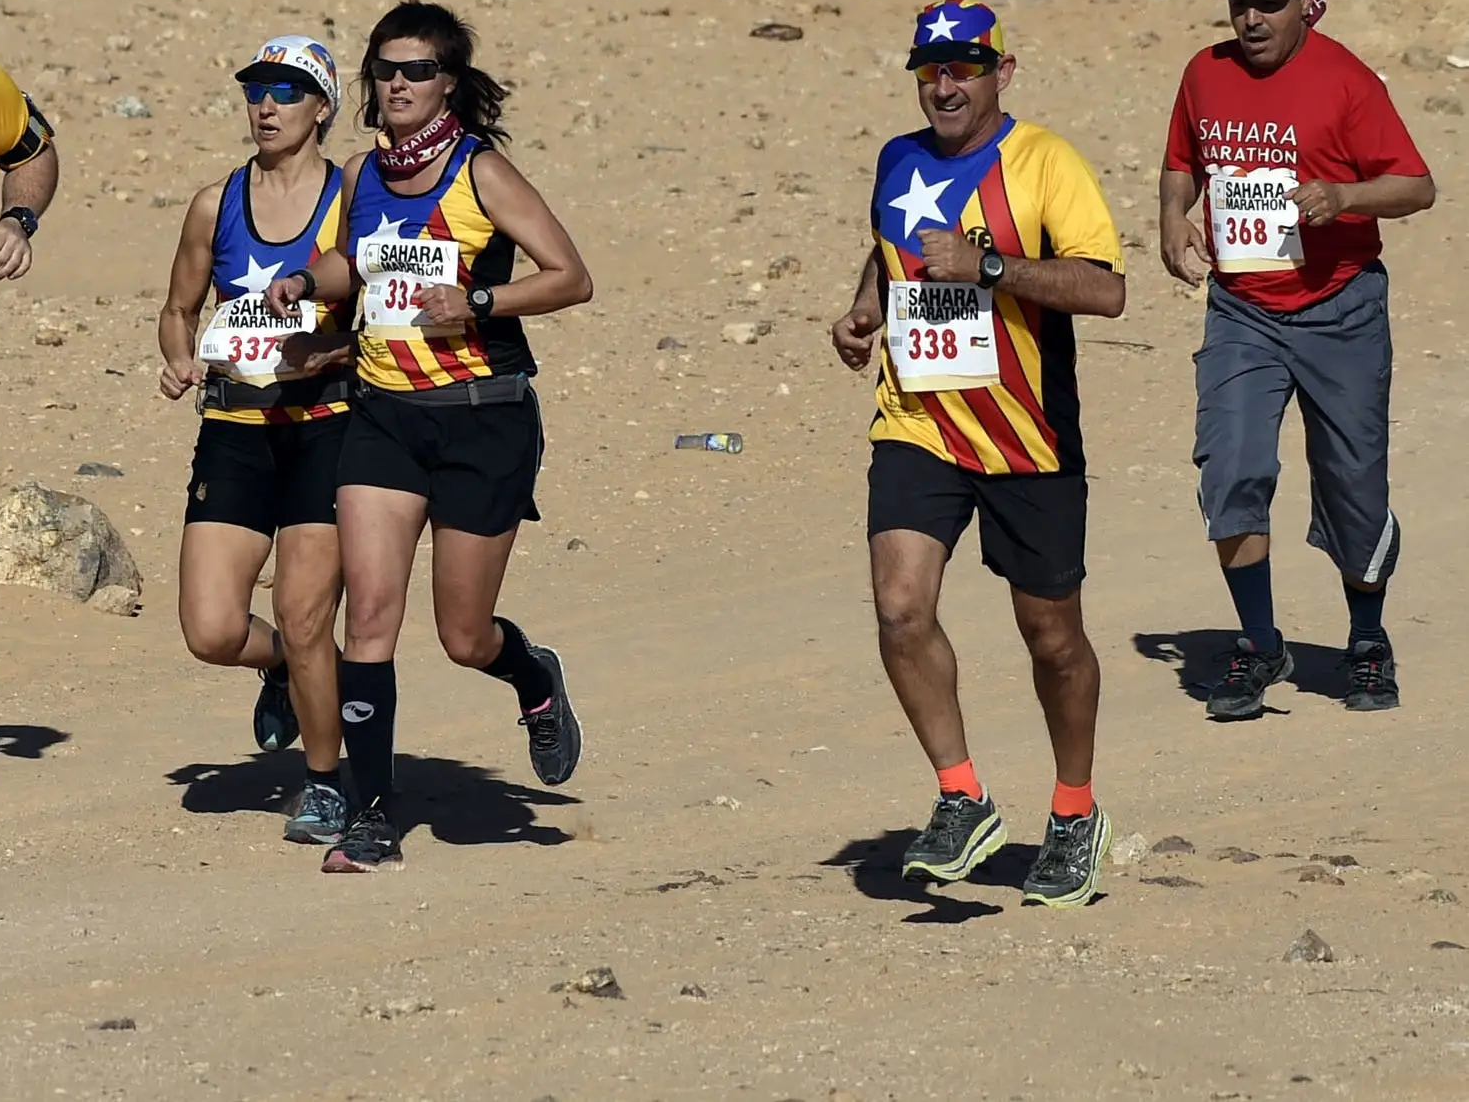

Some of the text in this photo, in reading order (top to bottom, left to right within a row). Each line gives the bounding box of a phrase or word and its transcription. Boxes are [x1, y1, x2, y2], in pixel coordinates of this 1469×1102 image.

[1199, 119, 1297, 146] SAHARA
[1225, 181, 1285, 199] SAHARA
[1225, 199, 1287, 211] MARATHON
[1226, 218, 1267, 245] 368
[380, 244, 444, 263] SAHARA
[908, 287, 980, 307] SAHARA
[230, 299, 301, 315] SAHA
[908, 306, 980, 320] MARATHON
[228, 316, 303, 329] MARATHON
[227, 336, 278, 362] 337
[908, 328, 958, 360] 338
